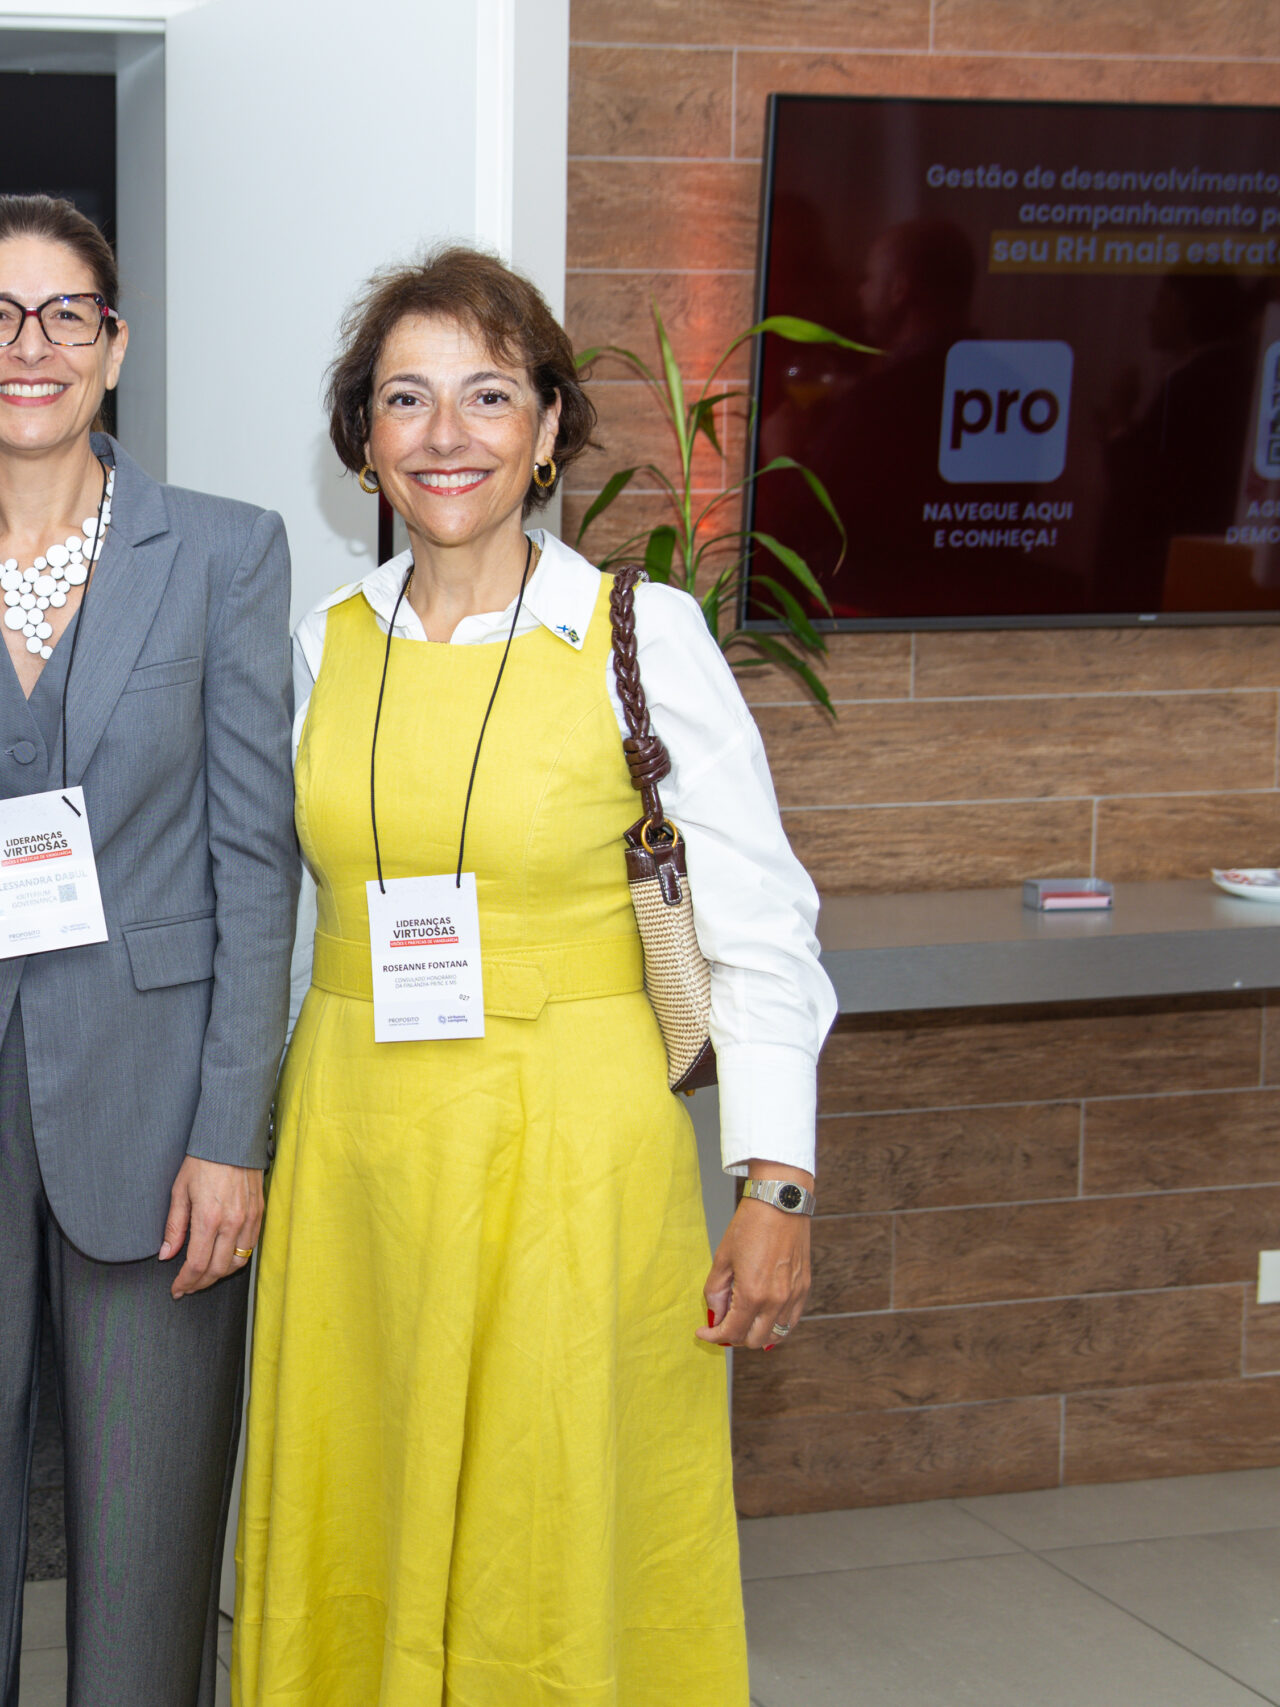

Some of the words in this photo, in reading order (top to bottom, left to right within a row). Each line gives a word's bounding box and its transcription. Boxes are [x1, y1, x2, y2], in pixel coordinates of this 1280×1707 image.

[926, 163, 1018, 190] Gestão
[1023, 164, 1056, 190] de
[1019, 204, 1257, 231] acompanhamento
[992, 239, 1049, 263] seu
[1055, 237, 1097, 263] RH
[1103, 235, 1180, 264] mais
[1186, 237, 1280, 265] estrat
[950, 387, 1060, 450] pro
[923, 502, 1019, 521] NAVEGUE
[1022, 502, 1073, 521] AQUI
[933, 530, 945, 548] E
[949, 529, 1058, 552] CONHEÇA!
[6, 830, 63, 847] LIDERANÇAS
[3, 839, 68, 858] VIRTUOSAS
[396, 916, 451, 928] LIDERANÇAS
[393, 926, 456, 939] VIRTUOSAS
[383, 962, 426, 972] ROSEANNE
[428, 960, 468, 969] FONTANA
